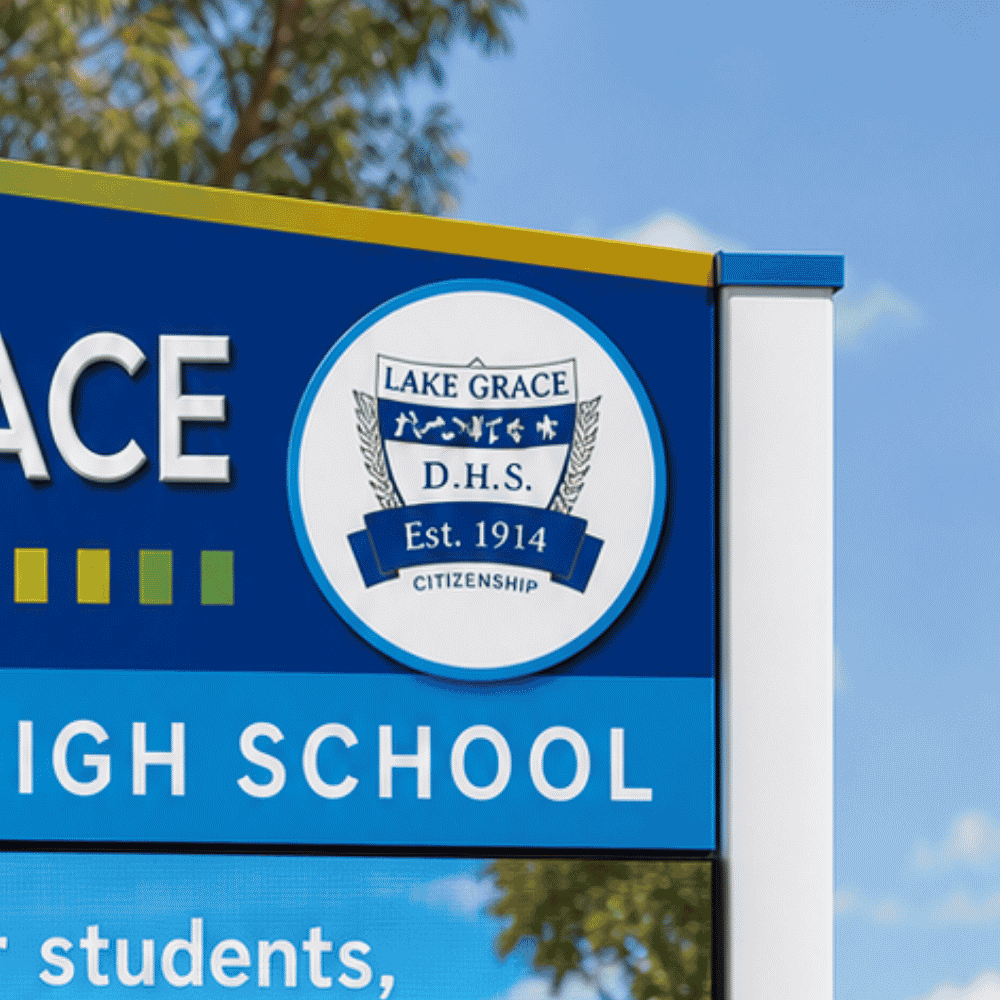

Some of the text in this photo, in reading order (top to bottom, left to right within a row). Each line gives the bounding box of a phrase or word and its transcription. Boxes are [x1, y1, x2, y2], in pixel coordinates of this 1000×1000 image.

[384, 366, 570, 401] LAKE GRACE
[422, 461, 533, 492] D.H.S.
[404, 520, 548, 553] Est. 1914
[412, 572, 539, 594] CITIZENSHIP
[237, 722, 654, 803] SCHOOL
[39, 917, 396, 1000] students,
